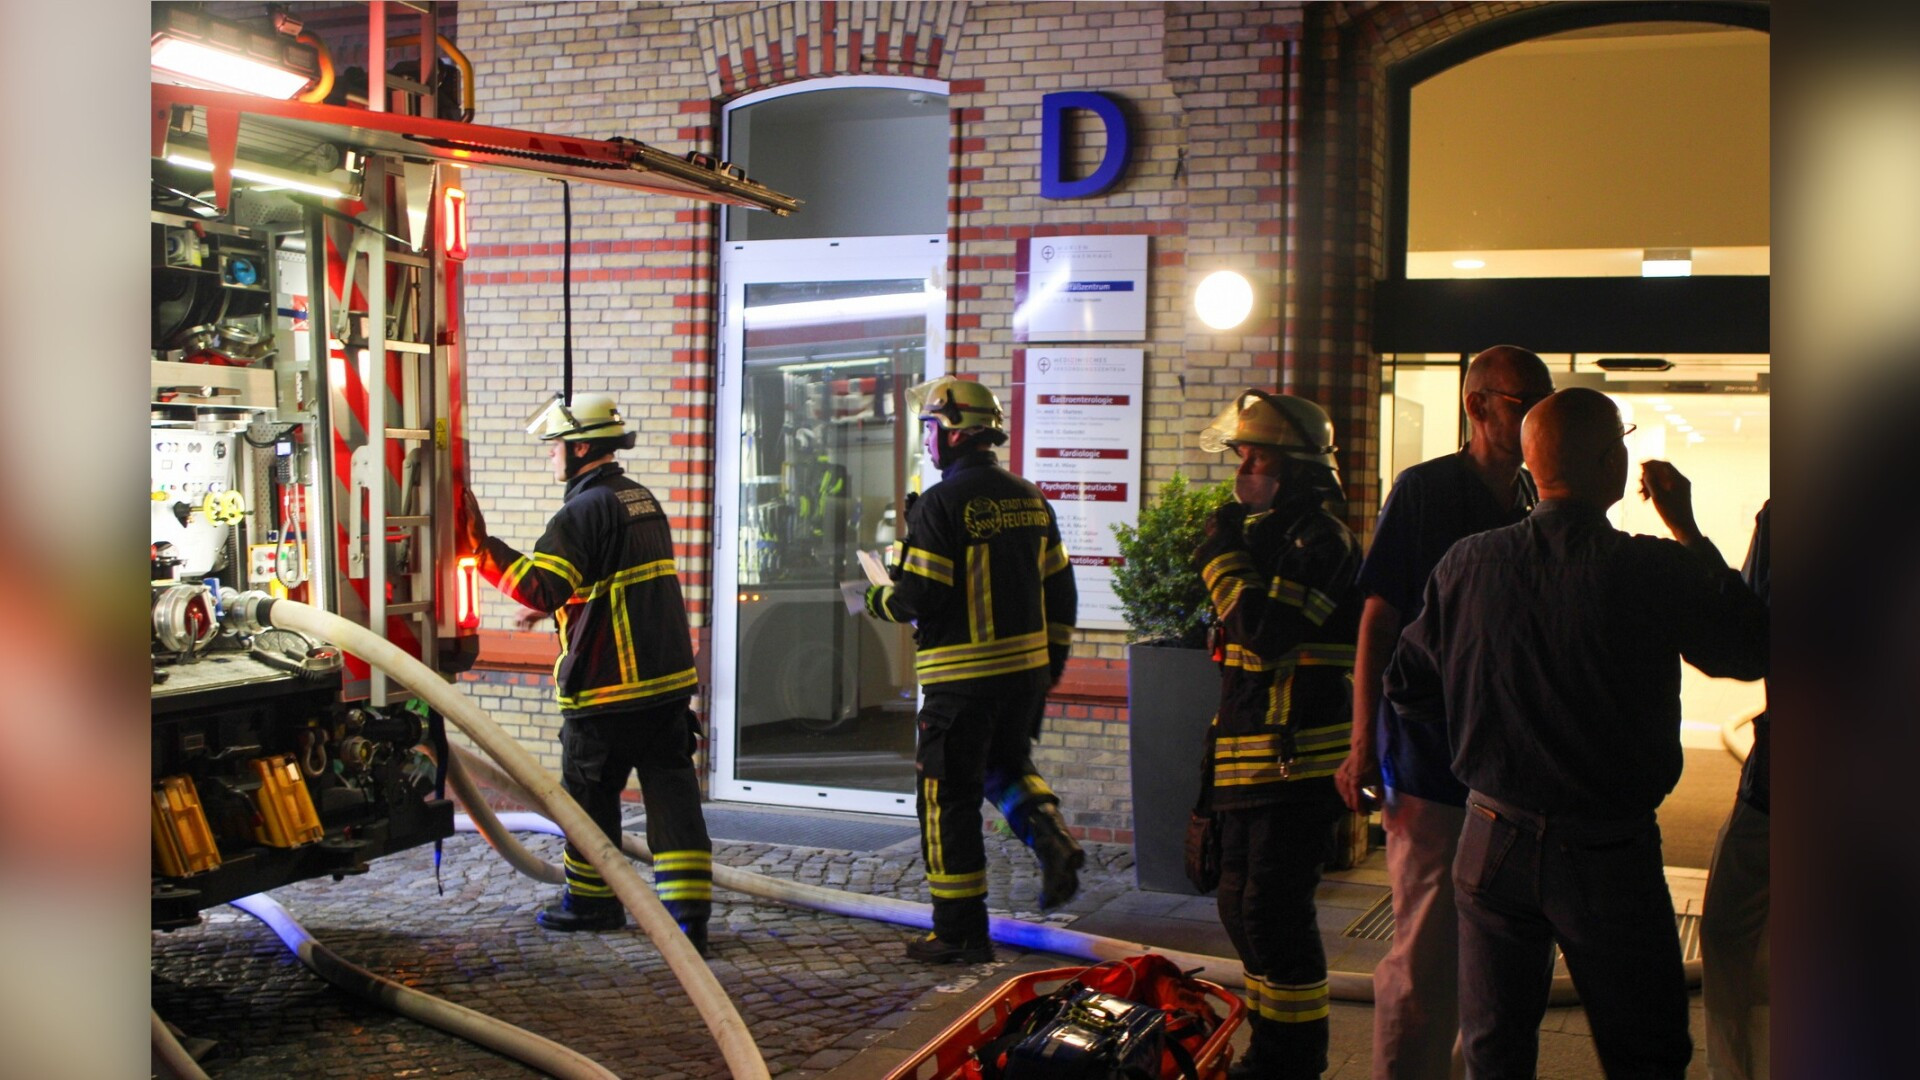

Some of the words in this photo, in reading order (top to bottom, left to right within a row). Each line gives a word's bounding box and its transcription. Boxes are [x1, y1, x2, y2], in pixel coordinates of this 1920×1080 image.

[1041, 91, 1131, 200] D
[1050, 395, 1114, 405] Gastroenterologie
[1059, 449, 1101, 458] Kardiologie
[1041, 482, 1118, 492] Psychotherpeutische
[1060, 493, 1097, 501] Ambuanz
[1000, 498, 1022, 510] STADT
[1003, 510, 1050, 528] FEUERWEH
